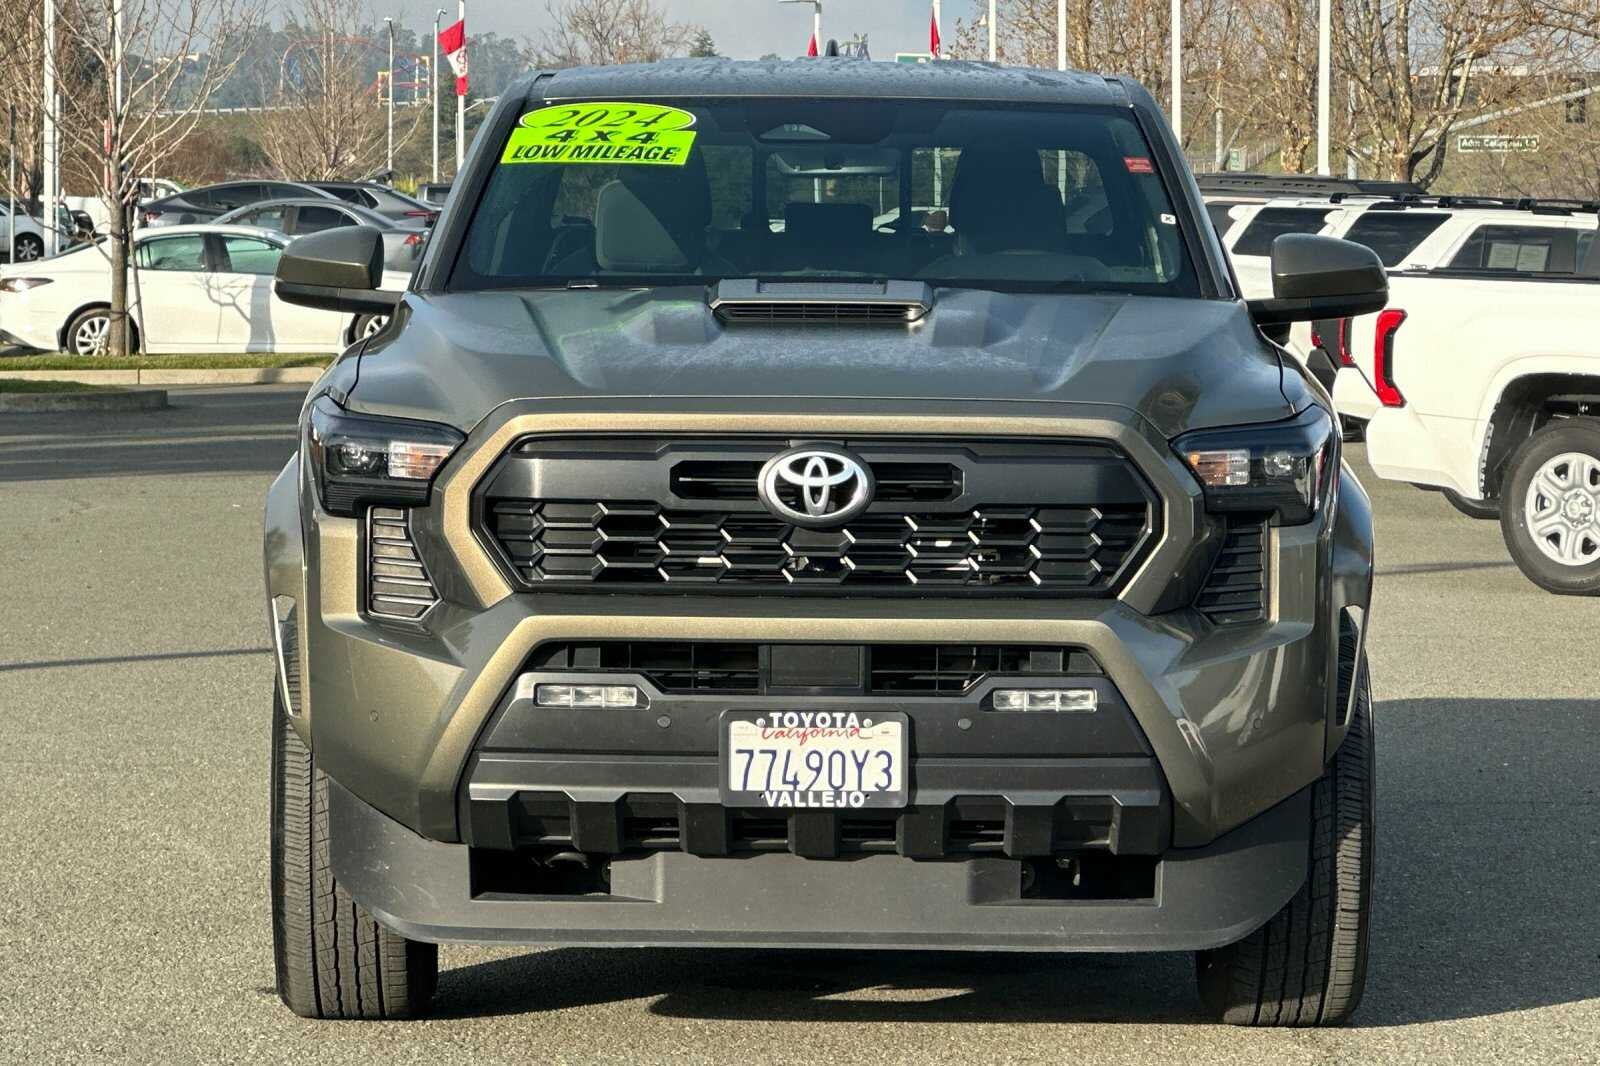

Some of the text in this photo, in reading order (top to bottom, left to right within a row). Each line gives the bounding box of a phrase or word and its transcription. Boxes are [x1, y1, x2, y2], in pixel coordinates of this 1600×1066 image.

[543, 109, 673, 127] 2024
[511, 144, 679, 161] LOW MILEAGE
[769, 712, 860, 728] TOYOTA
[735, 748, 893, 791] 77490Y3
[764, 791, 865, 808] VALLEJO
